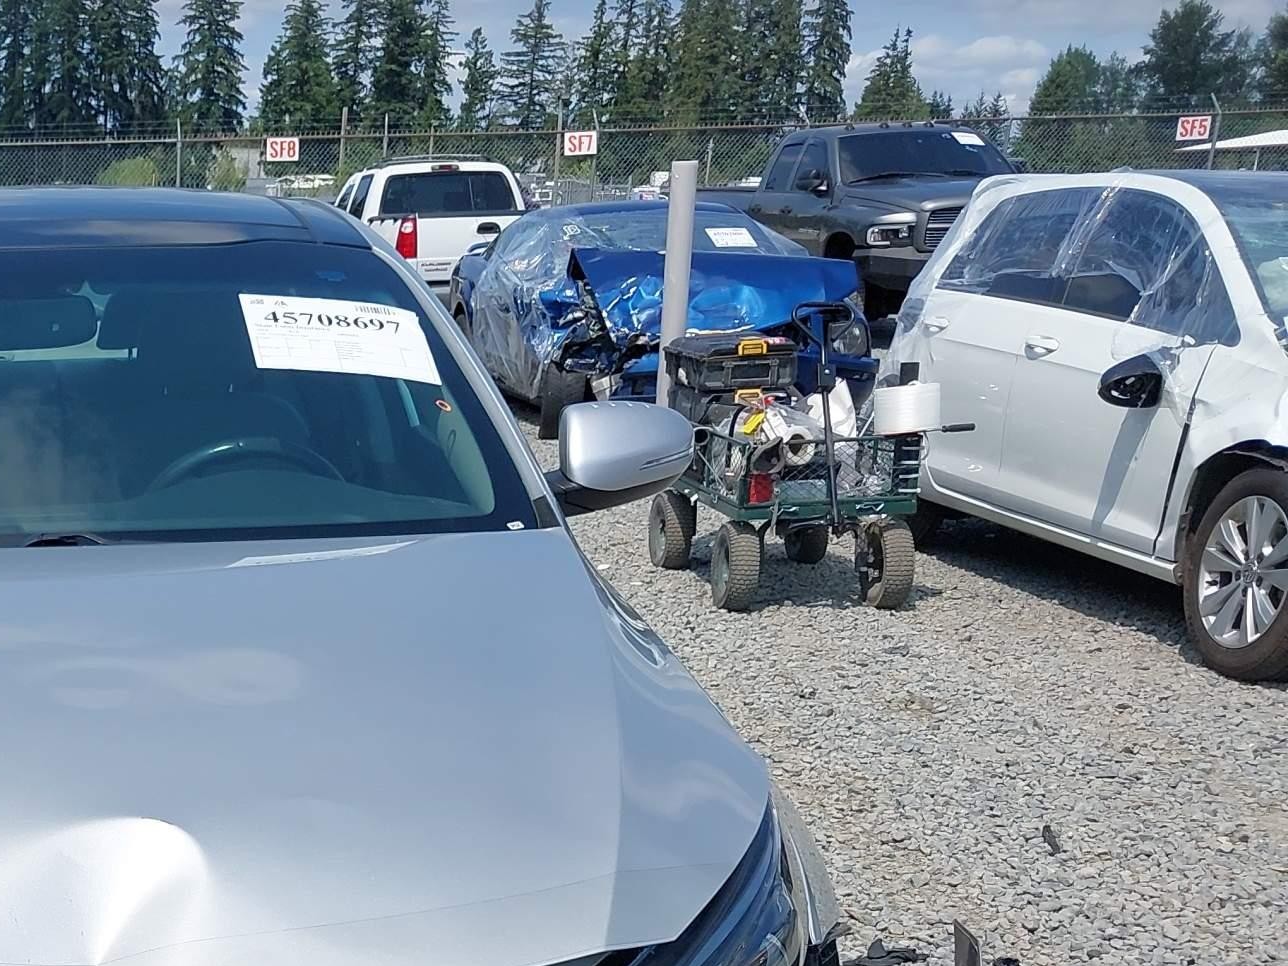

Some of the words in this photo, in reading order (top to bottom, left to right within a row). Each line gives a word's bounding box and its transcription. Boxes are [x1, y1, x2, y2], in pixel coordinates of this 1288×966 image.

[1179, 118, 1209, 137] SF5
[270, 140, 296, 158] SF8
[568, 134, 593, 153] SF7
[264, 310, 400, 334] 45708697
